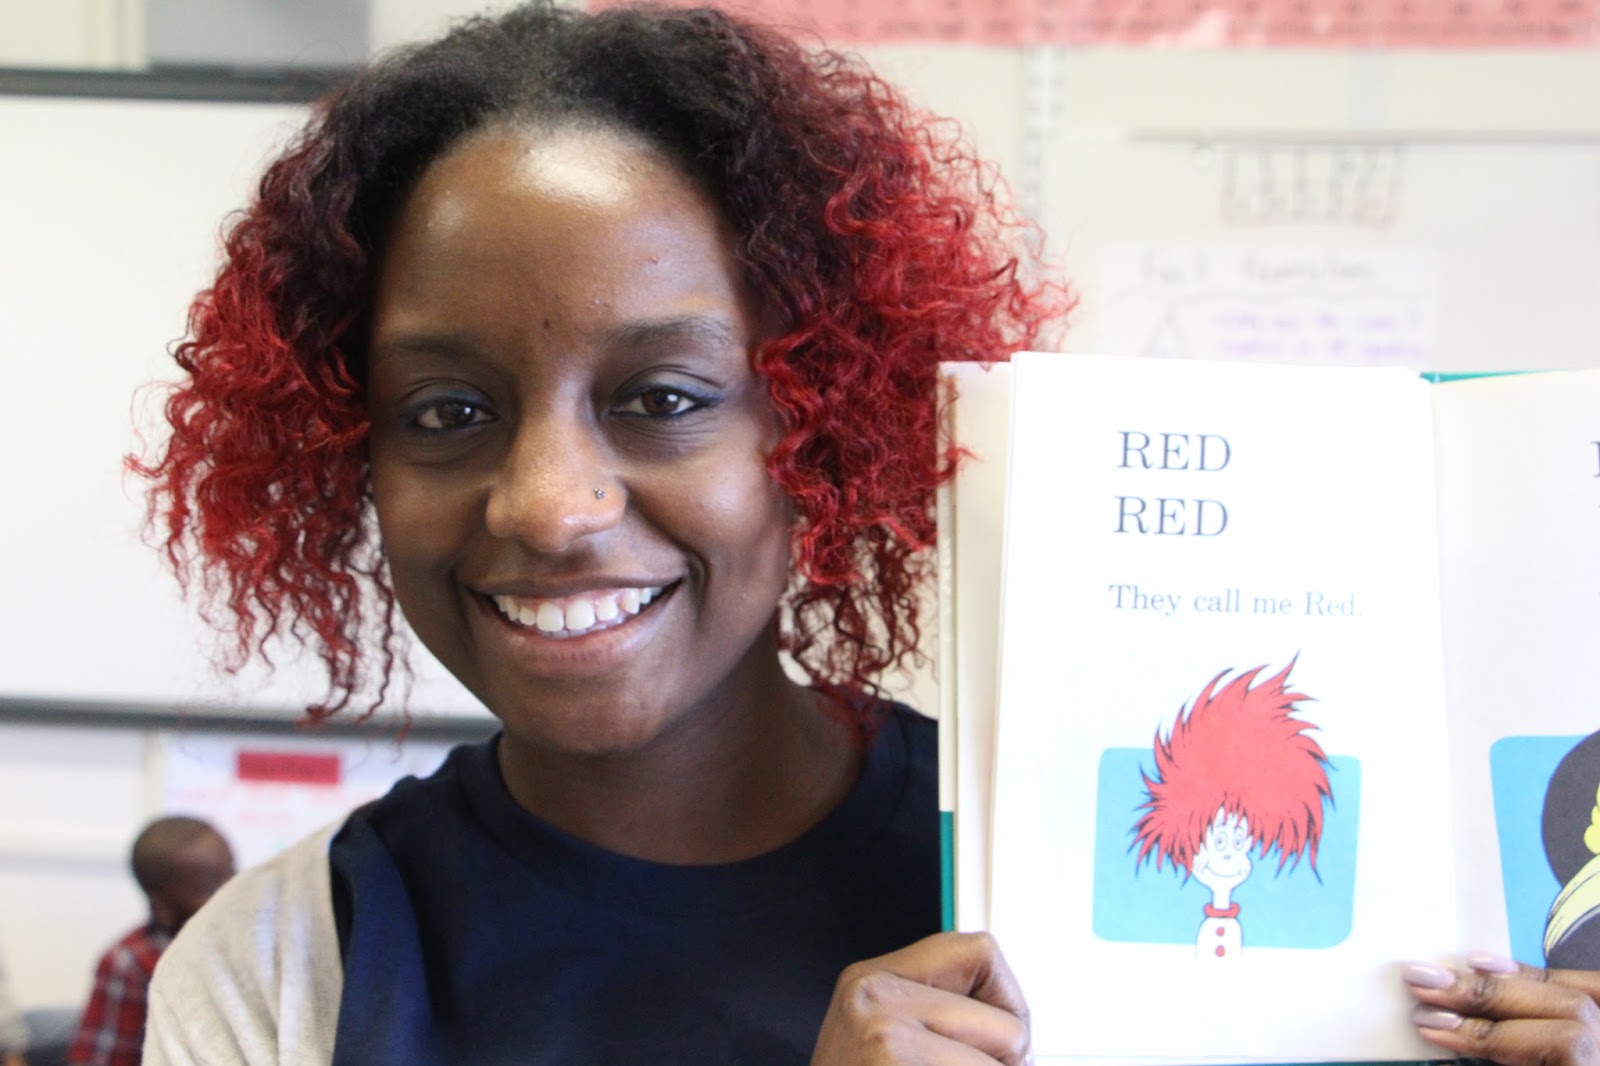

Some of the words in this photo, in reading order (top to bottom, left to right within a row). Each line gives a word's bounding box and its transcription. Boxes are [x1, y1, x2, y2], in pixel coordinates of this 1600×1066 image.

[1118, 431, 1232, 472] RED
[1113, 496, 1229, 537] RED
[1109, 585, 1182, 616] They
[1194, 589, 1241, 613] call
[1252, 597, 1293, 615] me
[1305, 592, 1363, 616] Red.
